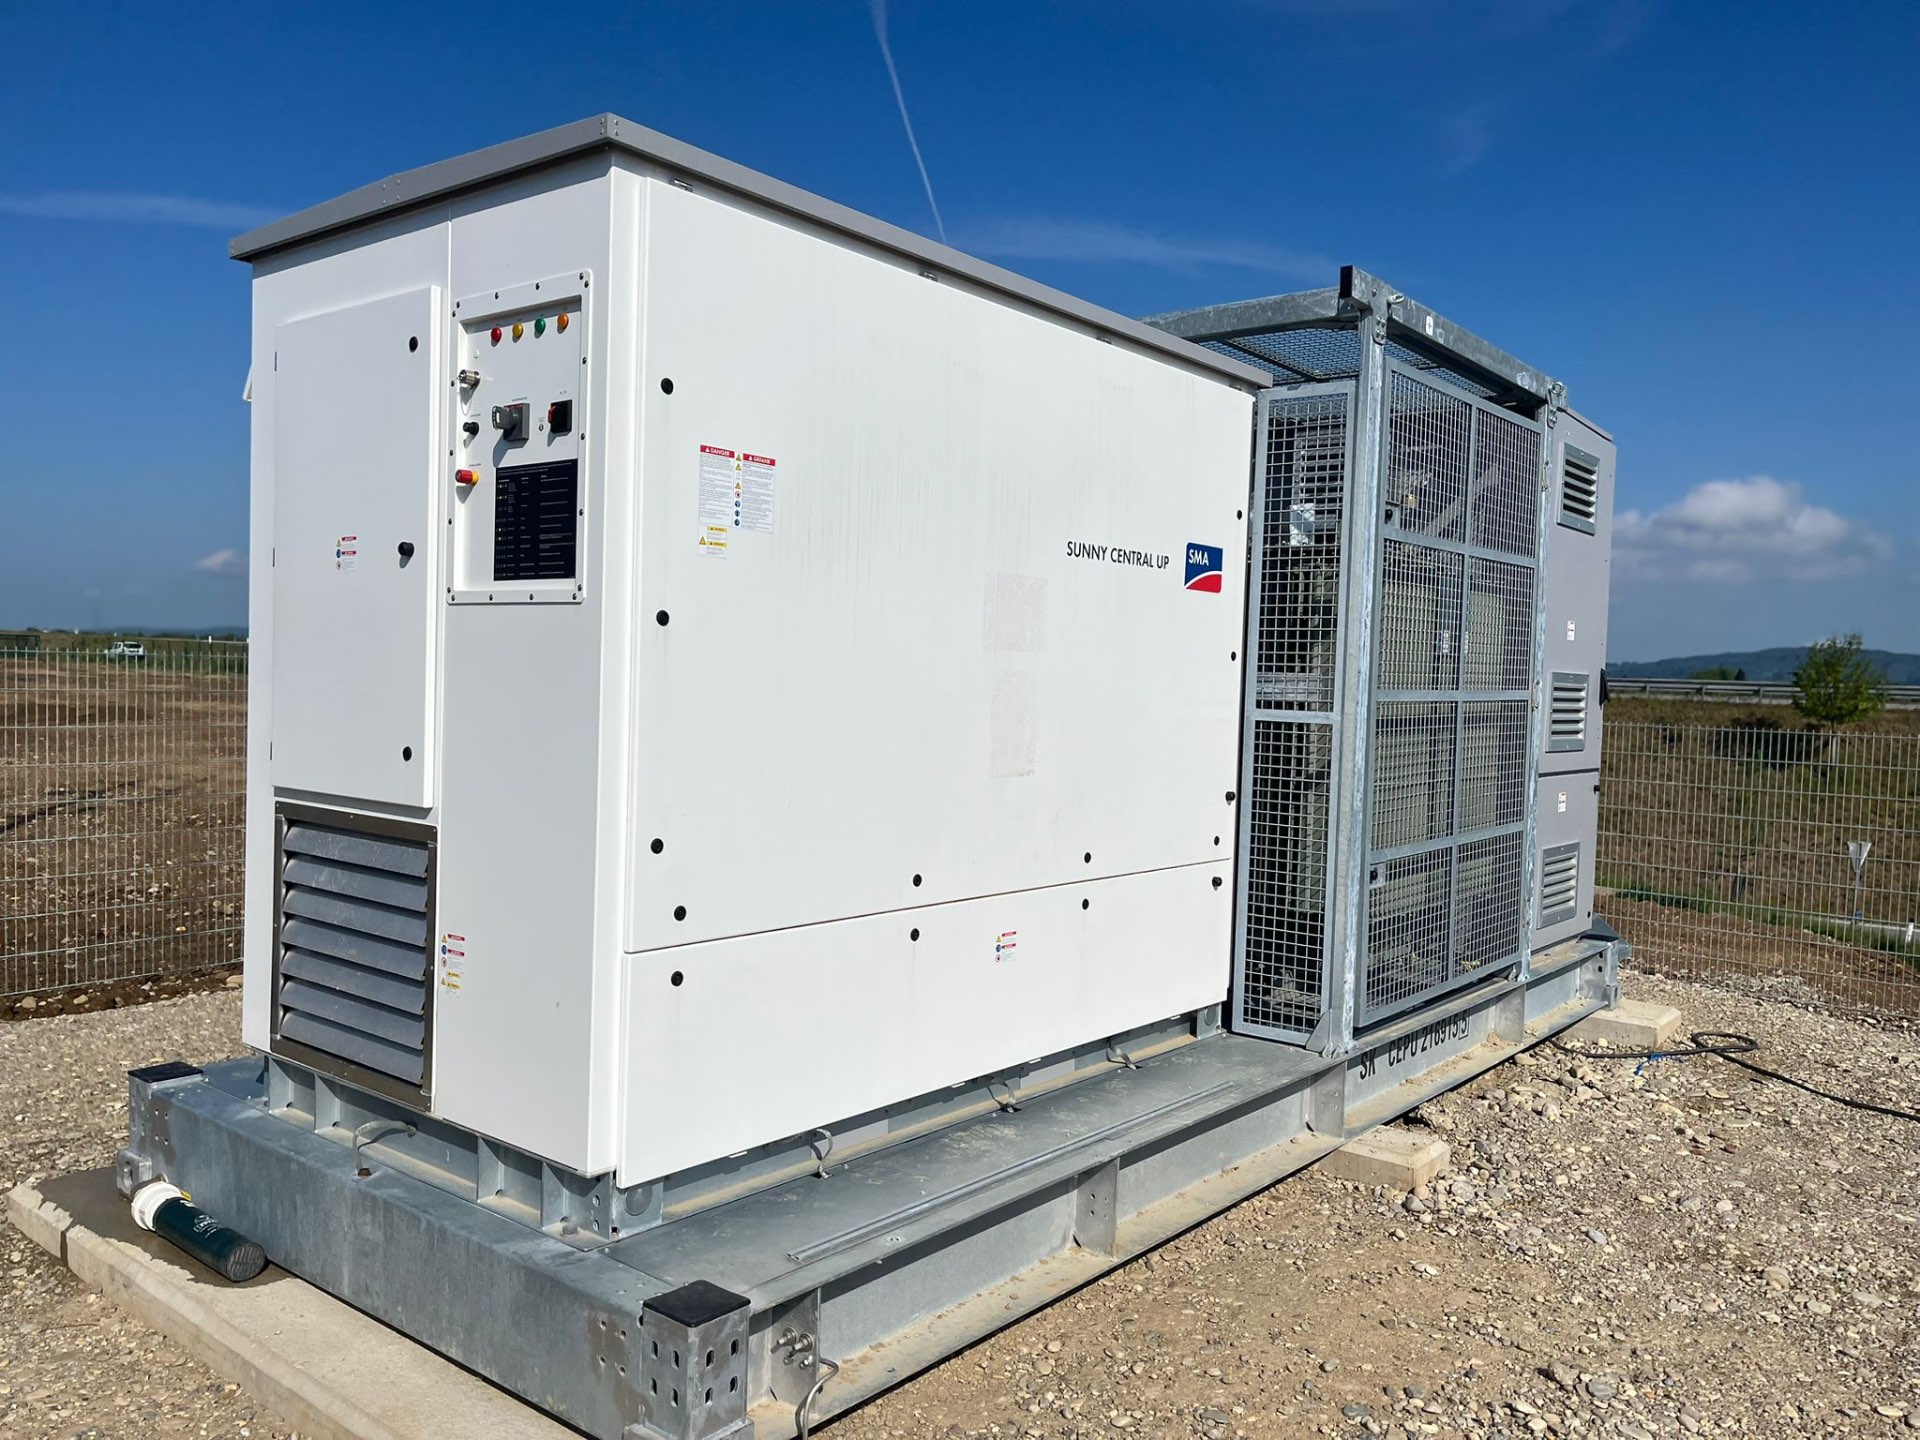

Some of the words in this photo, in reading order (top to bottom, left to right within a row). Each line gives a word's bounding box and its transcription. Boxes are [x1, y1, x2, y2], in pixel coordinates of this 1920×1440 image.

[1066, 540, 1108, 561] SUNNY
[1110, 547, 1154, 568] CENTRAL
[1156, 554, 1170, 570] UP
[1187, 548, 1210, 566] SMA
[1360, 1047, 1376, 1080] SK
[1388, 1030, 1418, 1067] CEPU
